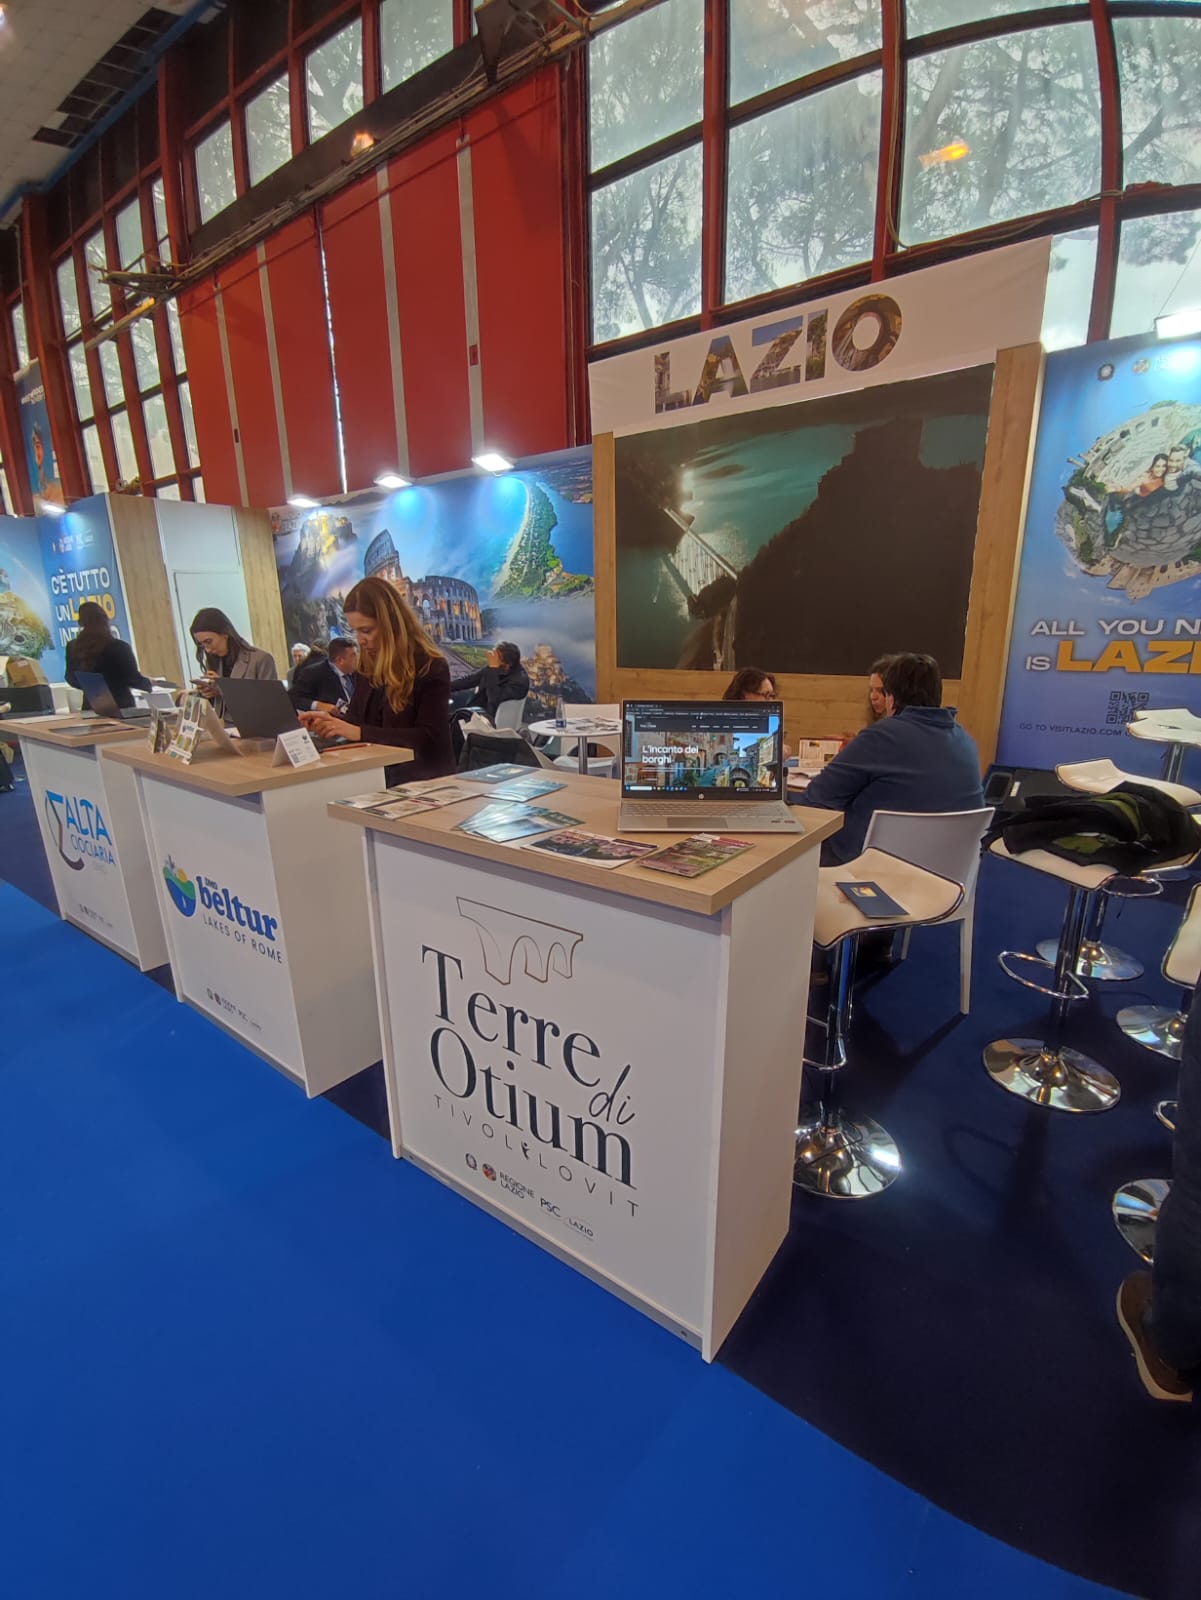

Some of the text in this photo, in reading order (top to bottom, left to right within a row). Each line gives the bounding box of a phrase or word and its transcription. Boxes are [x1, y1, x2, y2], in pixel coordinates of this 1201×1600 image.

[654, 293, 902, 414] LAZIO
[67, 567, 110, 592] TUTTO
[56, 604, 70, 621] UN
[1032, 620, 1085, 635] ALL
[1098, 619, 1164, 635] YOU
[1025, 656, 1051, 671] IS
[642, 744, 699, 754] L'incanto dei
[642, 754, 672, 765] borghi
[196, 875, 278, 941] beltur
[203, 912, 283, 964] LAKES OF ROME
[421, 944, 602, 1088] Terre
[589, 1064, 636, 1125] di
[430, 1026, 638, 1191] Otium
[499, 1172, 535, 1198] REGIONE
[500, 1180, 525, 1199] LAZIO
[540, 1197, 561, 1218] PSC
[568, 1218, 594, 1237] LAZIO
